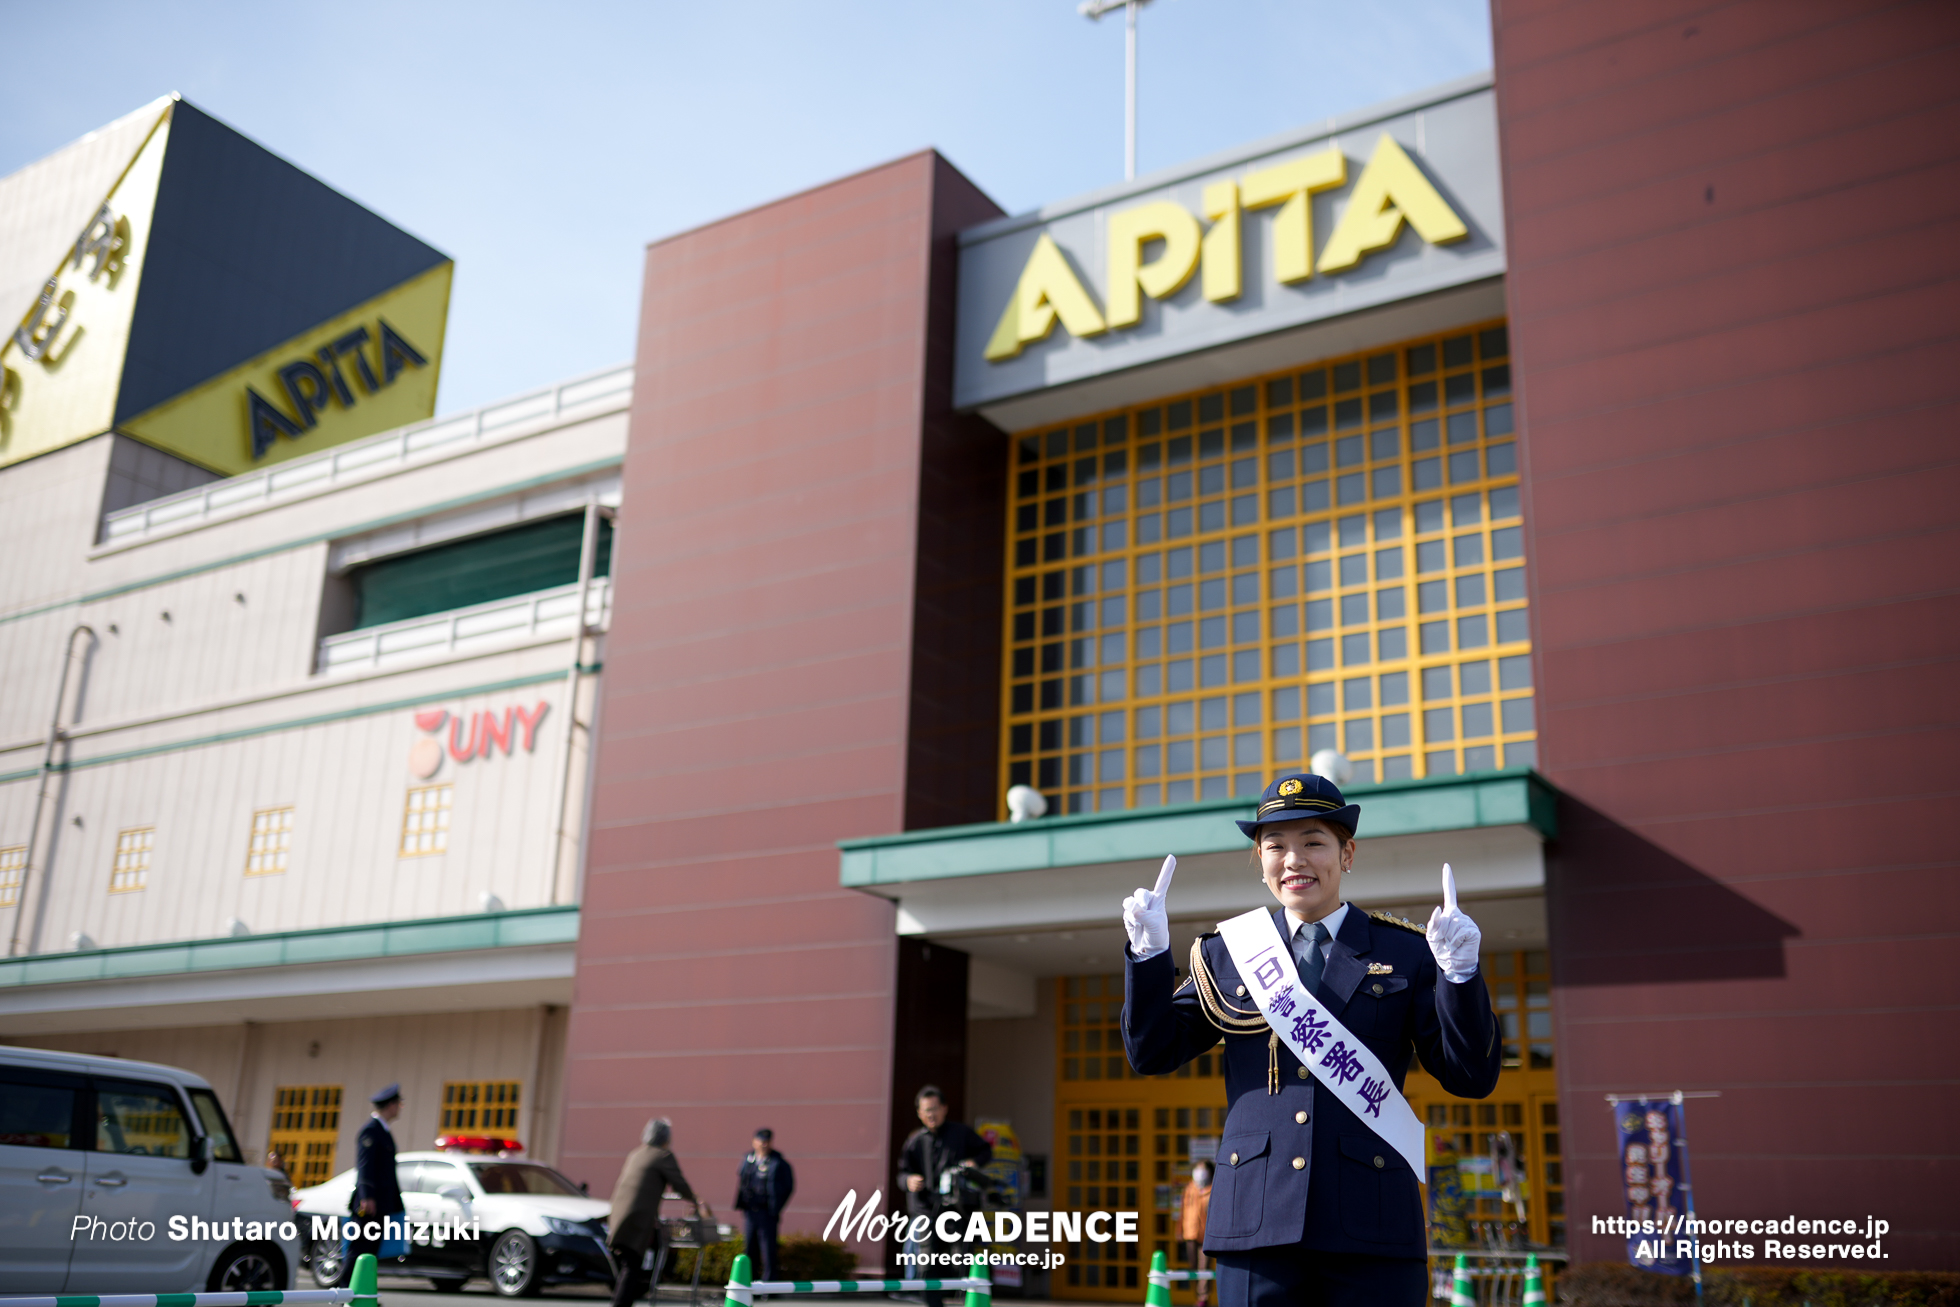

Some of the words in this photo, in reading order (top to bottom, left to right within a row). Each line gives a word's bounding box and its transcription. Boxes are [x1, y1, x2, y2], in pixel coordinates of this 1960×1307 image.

[983, 131, 1469, 363] APITA
[245, 316, 429, 460] APITA
[449, 699, 549, 763] UNY
[1243, 944, 1391, 1119] 一日警察署長
